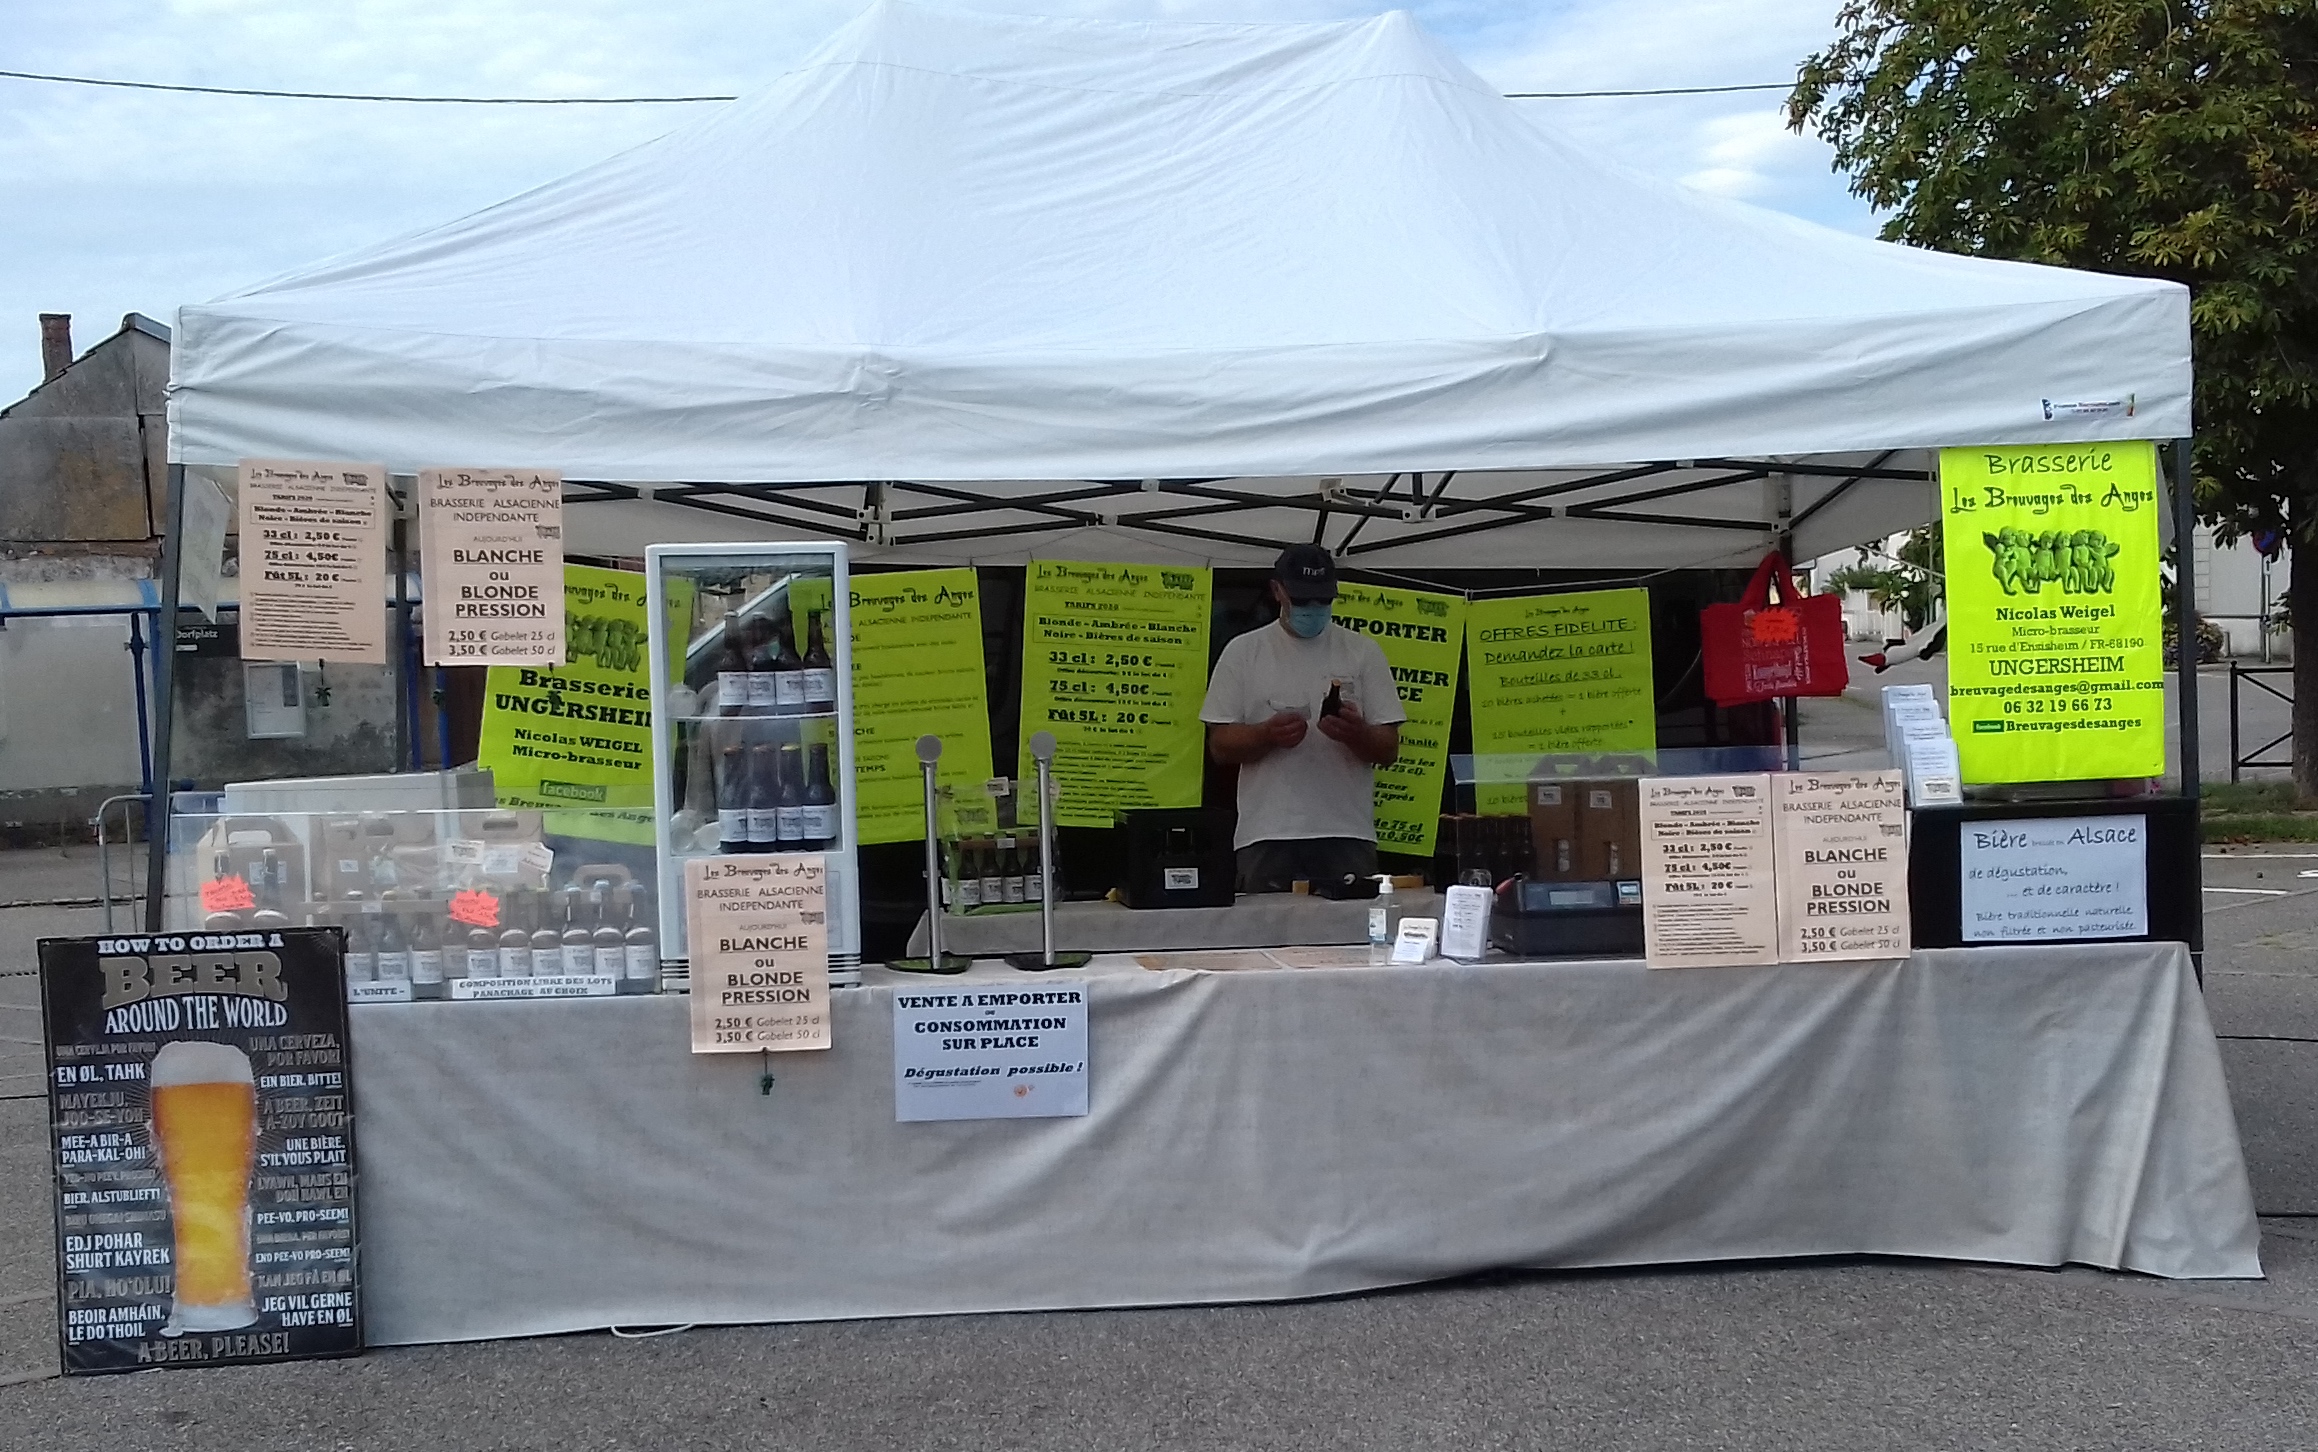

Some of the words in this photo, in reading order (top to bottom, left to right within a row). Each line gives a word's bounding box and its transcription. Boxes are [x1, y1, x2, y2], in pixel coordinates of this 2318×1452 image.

[1984, 448, 2112, 474] Brasserie
[430, 499, 485, 508] BRASSERIE
[493, 500, 560, 509] ALSACIENNE
[1950, 487, 1976, 514] Les
[1983, 486, 2064, 514] Breuvages
[2060, 484, 2093, 505] des
[2100, 483, 2153, 511] Anges
[453, 513, 539, 522] INDEPENDANTE
[454, 550, 543, 562] BLANCHE
[489, 572, 509, 581] ou
[461, 586, 538, 598] BLONDE
[456, 604, 545, 616] PRESSION
[1996, 607, 2056, 621] Nicolas
[2059, 604, 2115, 621] Weigel
[449, 631, 474, 642] 2,50
[479, 631, 487, 640] €
[491, 631, 527, 640] Gobelet
[531, 631, 543, 640] 25
[547, 631, 555, 640] cl
[1331, 615, 1448, 643] MPORTER
[1480, 625, 1549, 641] OFFRES
[1555, 619, 1627, 636] FIDELITE
[2012, 626, 2100, 636] Micro-brasseur
[449, 645, 474, 656] 3,50
[479, 645, 487, 654] €
[492, 645, 528, 655] Gobelet
[532, 645, 544, 655] 50
[548, 645, 555, 655] cl
[1485, 646, 1564, 664] Demandez
[1570, 644, 1583, 656] la
[1588, 642, 1624, 654] carte
[1970, 643, 1983, 653] 15
[1986, 645, 2006, 653] rue
[2090, 638, 2143, 649] FR-68190
[1049, 652, 1067, 662] 33
[1072, 653, 1087, 663] cl
[1105, 654, 1139, 667] 2,50
[1142, 656, 1152, 666] €
[1989, 656, 2125, 676] UNGERSHEIM
[520, 669, 650, 700] Brasserie
[1050, 681, 1067, 691] 75
[1073, 682, 1087, 692] cl
[1106, 683, 1149, 696] 4,50€
[1950, 680, 2164, 697] breuvagedesanges@gmail.com
[2004, 701, 2021, 714] 06
[2027, 700, 2043, 713] 32
[2050, 700, 2066, 712] 19
[2072, 699, 2089, 711] 66
[2094, 698, 2112, 710] 73
[2006, 718, 2141, 733] Breuvagesdesanges
[514, 728, 575, 746] Nicolas
[580, 737, 643, 753] WEIGEL
[513, 745, 642, 769] Micro-brasseur
[542, 781, 604, 799] facebook
[1783, 802, 1832, 811] BRASSERIE
[1840, 799, 1901, 809] ALSACIENNE
[1804, 813, 1882, 823] INDEPENDANTE
[1974, 830, 2027, 849] Bière
[2068, 827, 2136, 845] Alsace
[1805, 848, 1887, 862] BLANCHE
[1838, 870, 1856, 878] ou
[1969, 868, 1982, 879] de
[1987, 865, 2068, 881] dégustation,
[697, 889, 750, 898] BRASSERIE
[759, 886, 824, 896] ALSACIENNE
[1813, 883, 1883, 896] BLONDE
[2023, 886, 2033, 896] et
[2038, 884, 2051, 895] de
[2056, 883, 2111, 895] caractère
[720, 900, 803, 911] INDEPENDANTE
[1807, 900, 1890, 914] PRESSION
[1976, 912, 2002, 921] Bière
[2008, 908, 2079, 920] traditionnelle
[2085, 906, 2133, 915] naturelle
[99, 939, 150, 953] HOW
[155, 938, 184, 951] TO
[191, 935, 266, 950] ORDER
[269, 934, 284, 947] A
[720, 936, 807, 951] BLANCHE
[755, 959, 774, 968] ou
[100, 951, 288, 1010] BEER
[459, 980, 530, 988] COMPOSITION
[728, 972, 803, 986] BLONDE
[473, 989, 534, 998] PANACHAGE
[722, 989, 810, 1004] PRESSION
[899, 996, 957, 1008] VENTE
[962, 995, 974, 1007] A
[978, 992, 1081, 1006] EMPORTER
[105, 1001, 179, 1035] AROUND
[183, 996, 219, 1029] THE
[222, 997, 288, 1028] WORLD
[915, 1018, 1066, 1033] CONSOMMATION
[943, 1039, 975, 1050] SUR
[981, 1036, 1038, 1049] PLACE
[57, 1066, 76, 1082] EN
[104, 1063, 145, 1080] TAHK
[904, 1066, 1000, 1079] Dégustation
[1007, 1063, 1073, 1077] possible
[261, 1075, 277, 1088] EIN
[308, 1072, 341, 1086] BITTE!
[62, 1135, 100, 1149] MEE-A
[100, 1133, 132, 1147] BIR-A
[287, 1137, 308, 1150] UNE
[62, 1146, 146, 1163] PARA-KAL-OH!
[281, 1152, 312, 1166] VOUS
[66, 1236, 92, 1251] EDJ
[95, 1232, 142, 1250] POHAR
[66, 1252, 112, 1269] SHURT
[115, 1248, 170, 1266] KAYREK
[262, 1297, 285, 1312] JEG
[287, 1295, 309, 1310] VIL
[311, 1292, 352, 1308] GERNE
[69, 1309, 107, 1325] BEOIR
[282, 1312, 315, 1327] HAVE
[317, 1311, 333, 1324] EN
[337, 1309, 353, 1322] ØL
[69, 1326, 84, 1341] LE
[87, 1325, 105, 1340] DO
[107, 1322, 146, 1338] THOIL
[138, 1342, 151, 1363] A
[212, 1332, 290, 1358] PLEASE!
